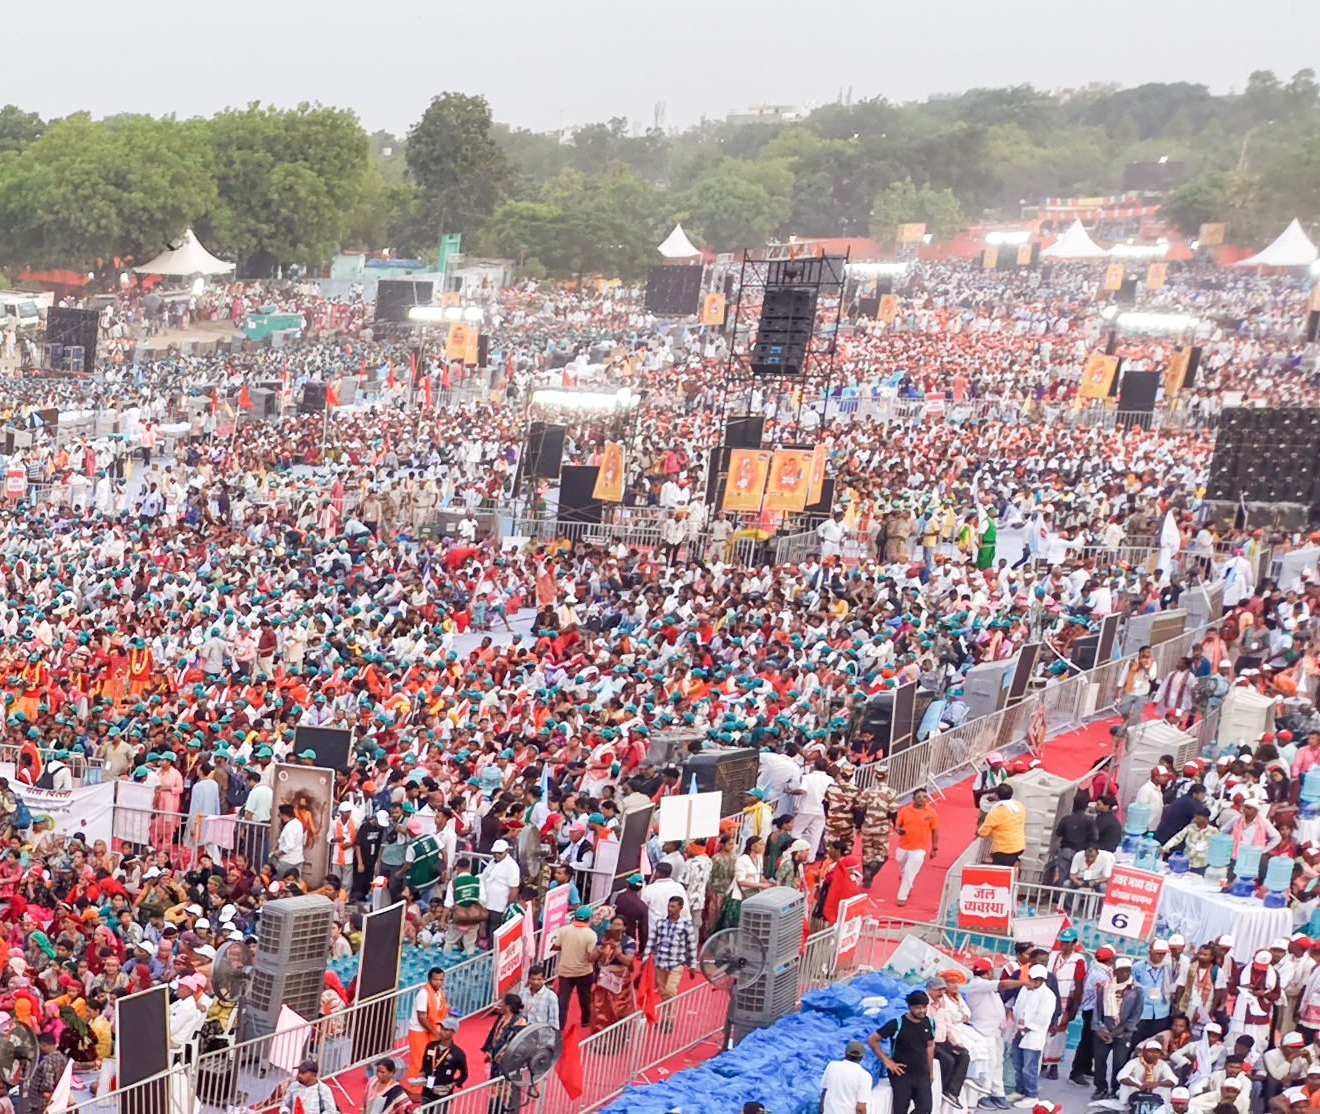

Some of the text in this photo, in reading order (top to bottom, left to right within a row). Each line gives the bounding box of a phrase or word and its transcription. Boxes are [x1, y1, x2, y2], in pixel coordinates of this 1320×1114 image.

[973, 887, 995, 900] जल
[964, 901, 1004, 917] व्यवस्था
[1111, 913, 1129, 929] 6
